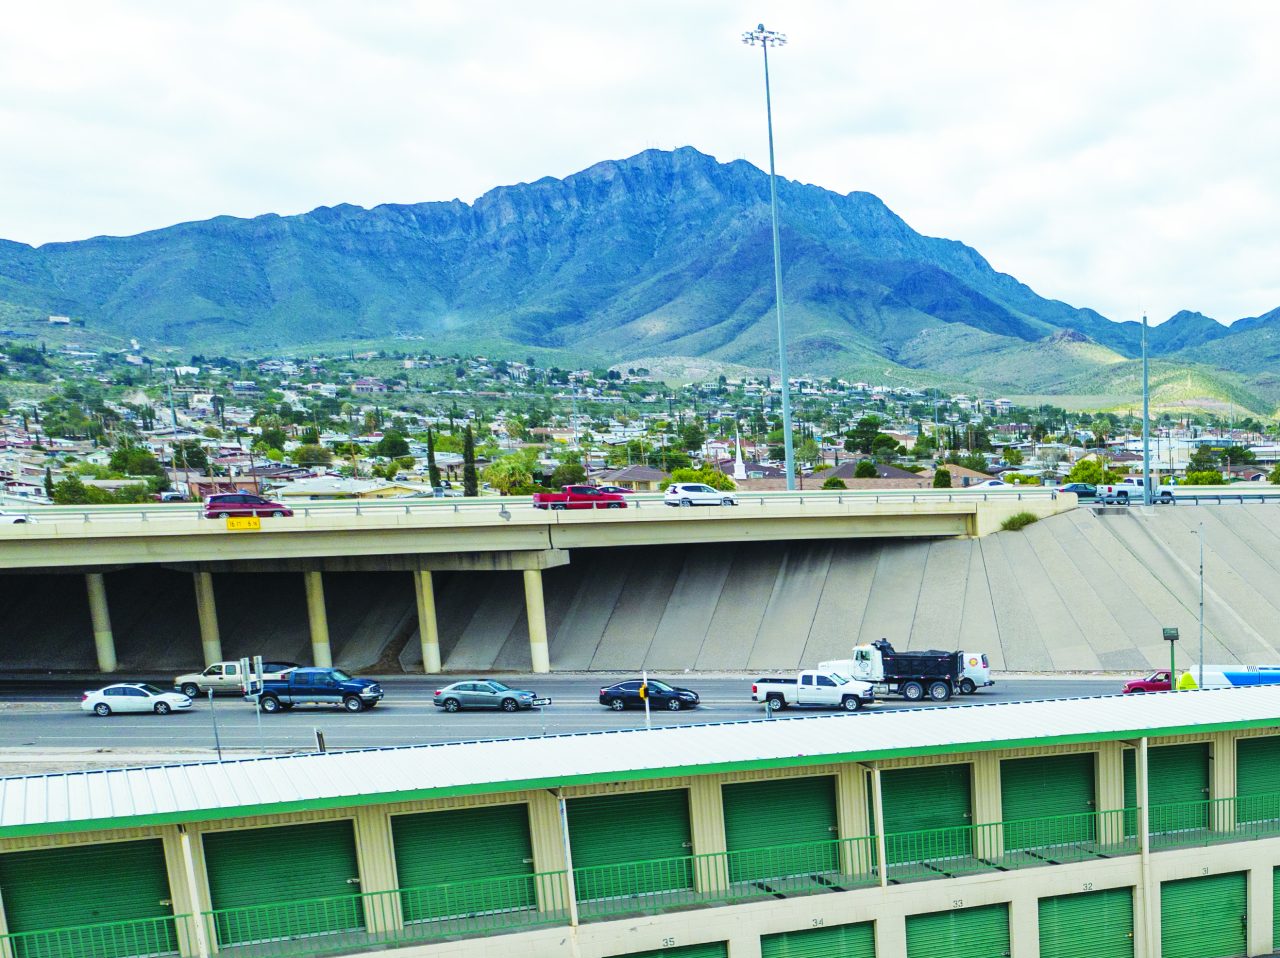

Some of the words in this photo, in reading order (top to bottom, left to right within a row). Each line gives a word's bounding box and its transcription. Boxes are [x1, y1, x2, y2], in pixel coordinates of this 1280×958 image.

[1083, 882, 1093, 891] 32
[952, 899, 964, 908] 33
[812, 918, 824, 927] 34
[662, 937, 675, 947] 35
